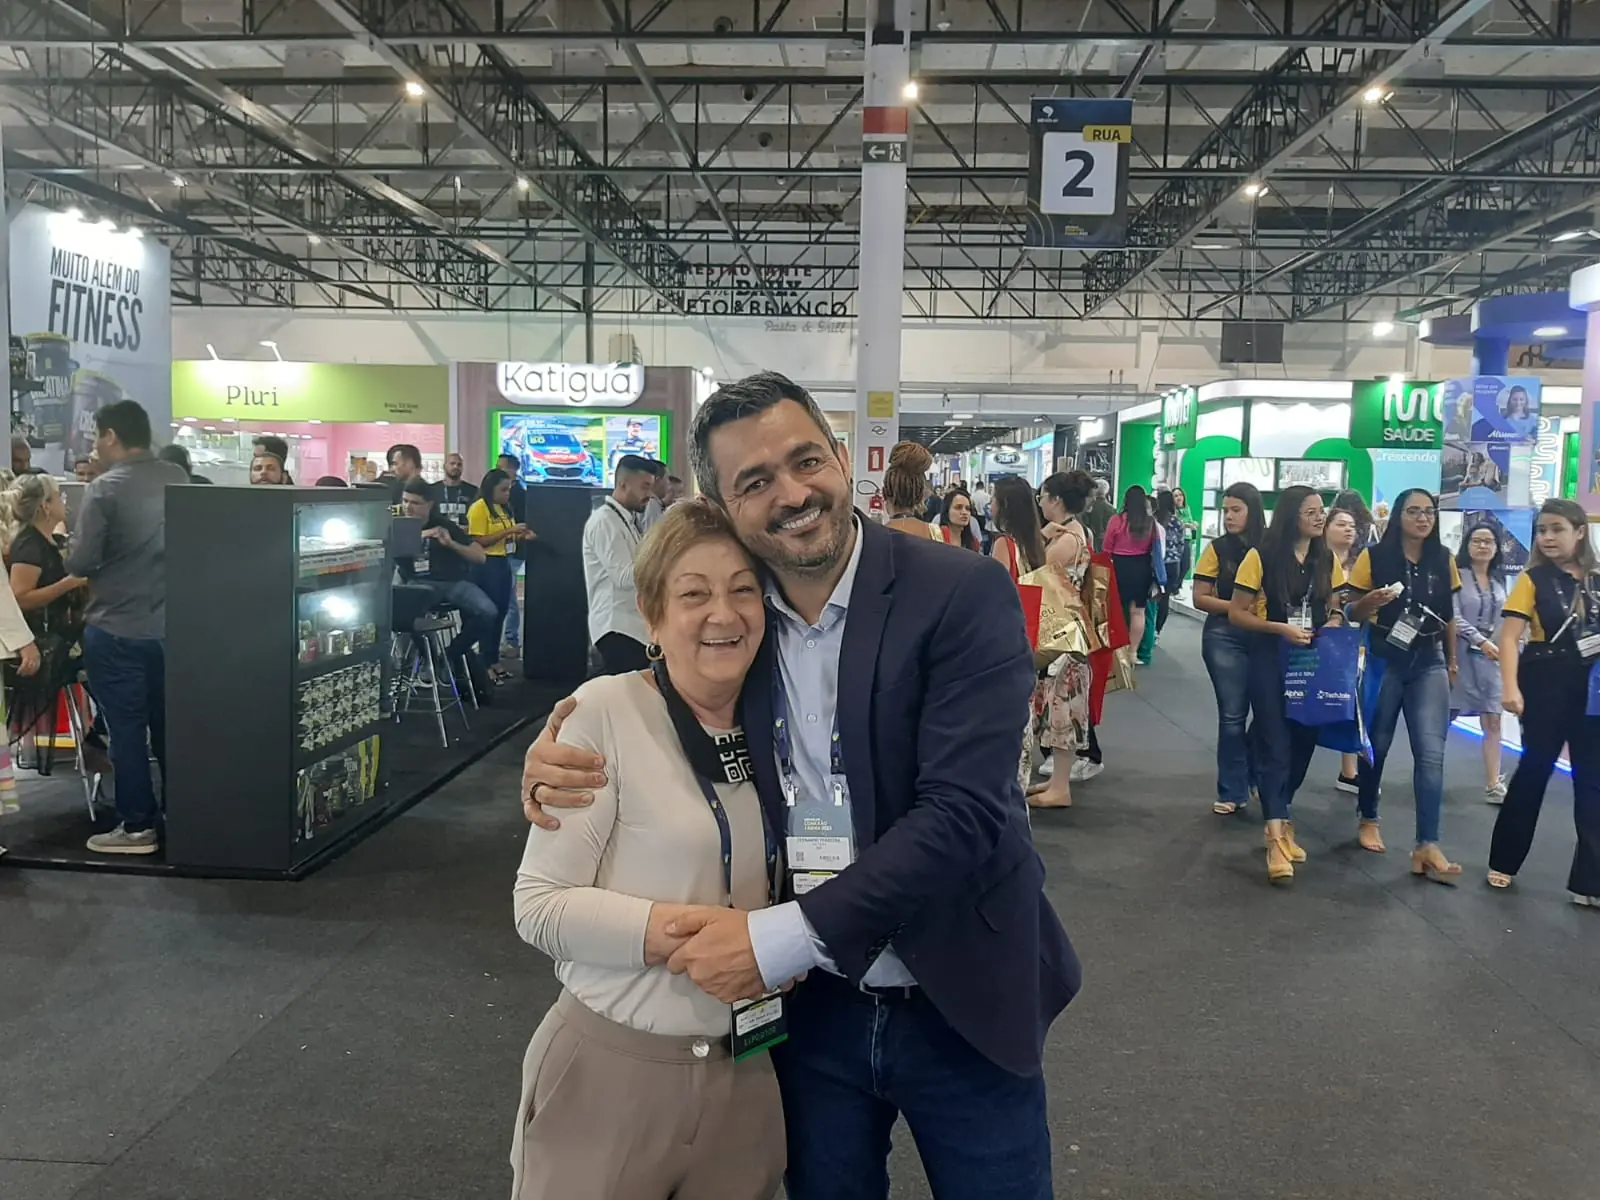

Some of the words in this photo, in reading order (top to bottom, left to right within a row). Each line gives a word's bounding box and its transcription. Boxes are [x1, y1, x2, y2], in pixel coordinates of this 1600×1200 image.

[1092, 129, 1121, 141] RUA
[1062, 150, 1095, 198] 2
[51, 246, 90, 283] MUITO
[125, 267, 140, 296] DO
[49, 279, 143, 352] FITNESS
[226, 385, 279, 407] Pluri
[1383, 425, 1435, 442] SAÚDE
[1377, 451, 1437, 463] rescendo
